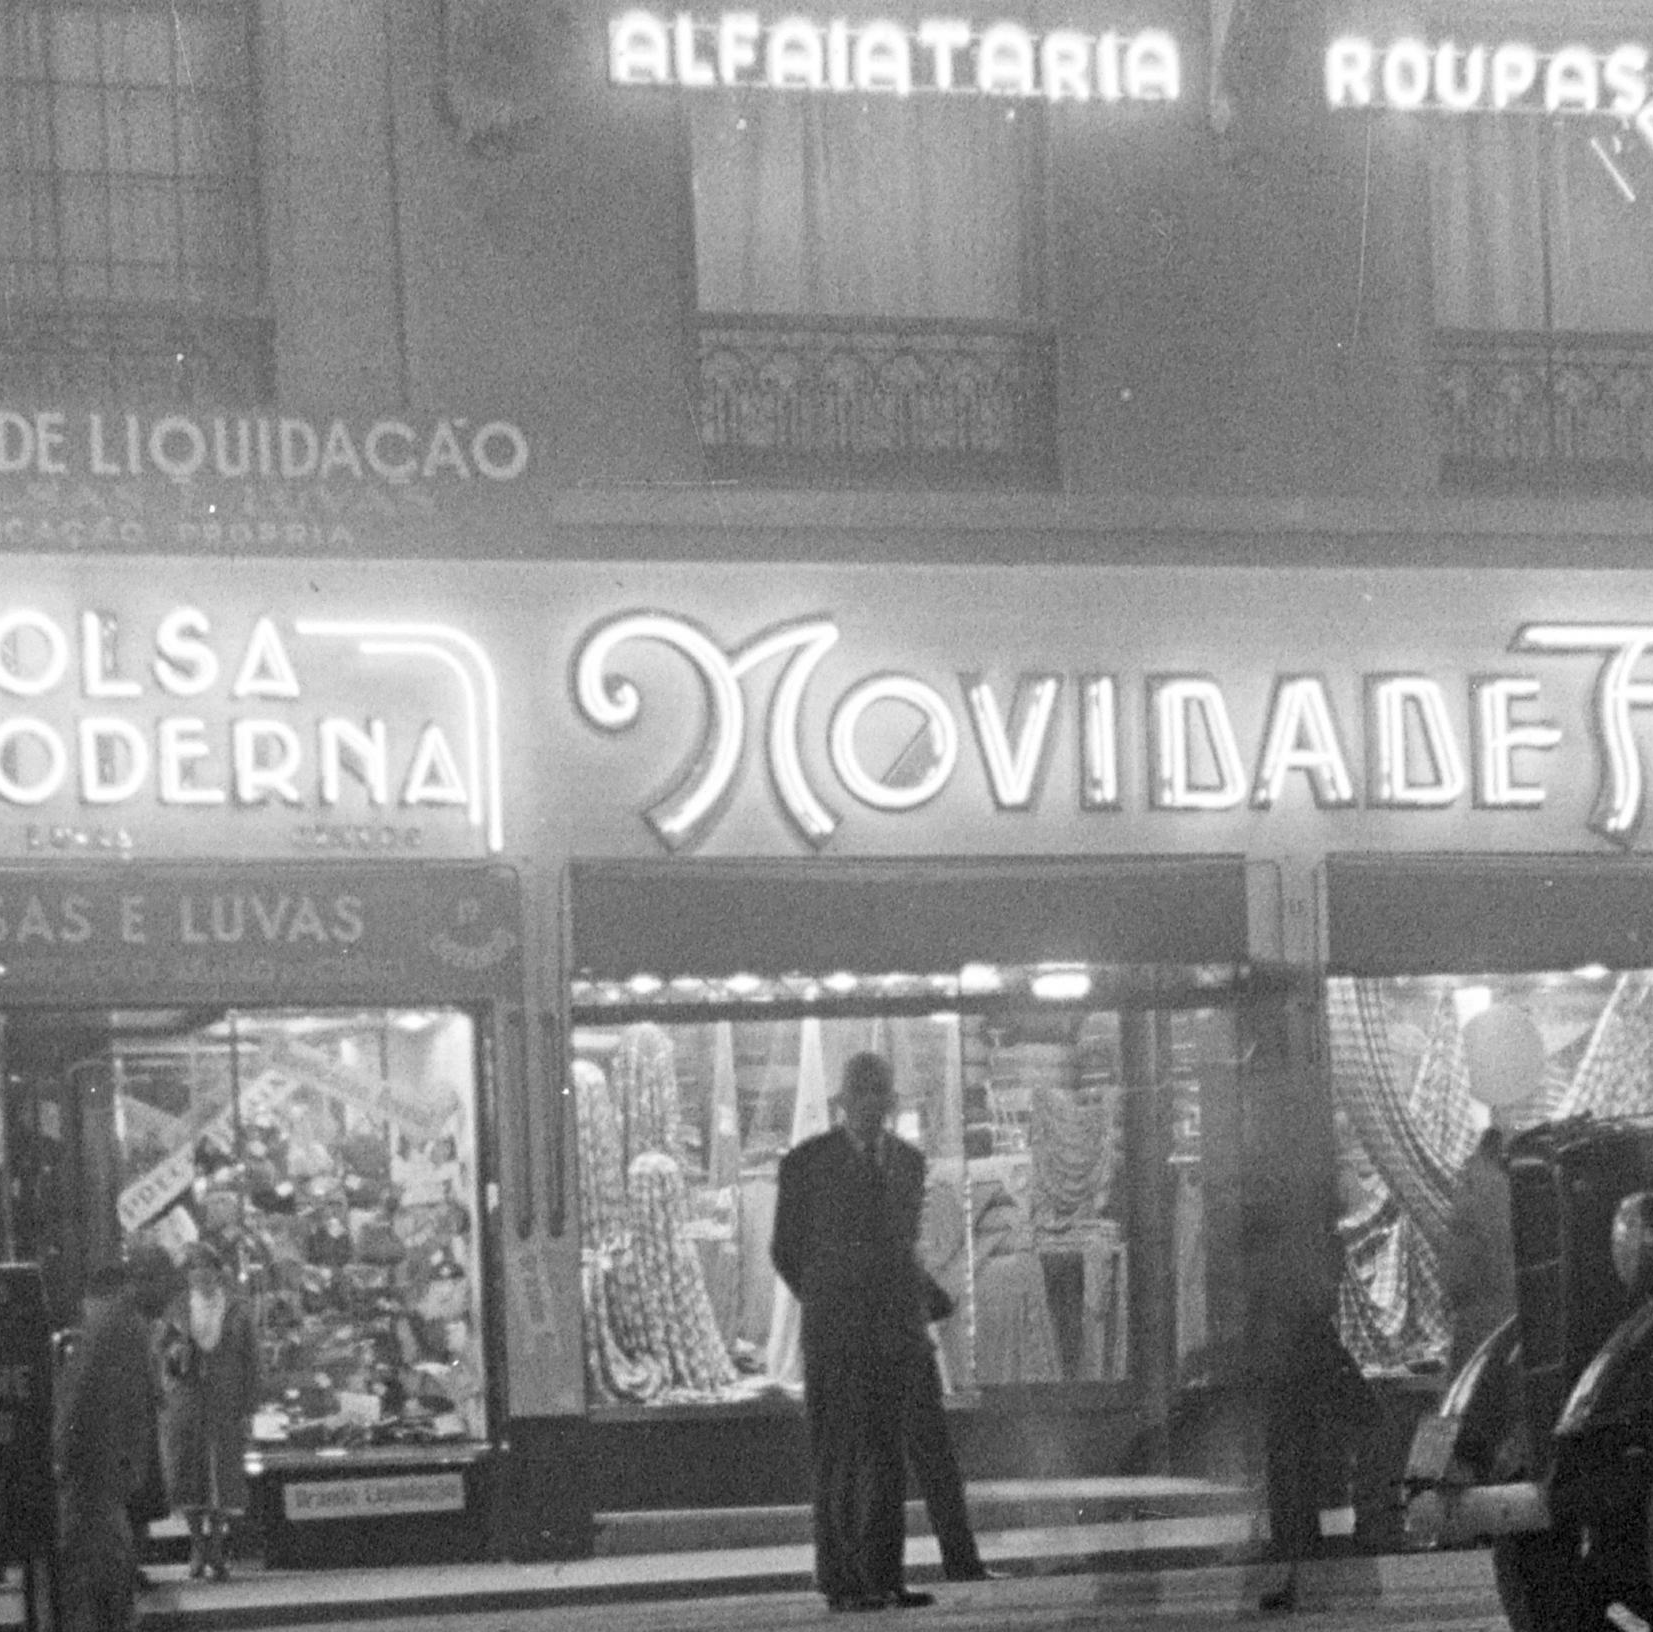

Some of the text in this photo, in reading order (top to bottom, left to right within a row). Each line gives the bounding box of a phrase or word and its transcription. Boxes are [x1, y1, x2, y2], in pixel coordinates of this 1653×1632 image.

[610, 13, 1180, 100] ALFAIATARIA
[1325, 37, 1649, 113] ROUPAS
[88, 413, 529, 486] LIQUIDAÇÃO
[568, 608, 1563, 852] NOVIDADE
[119, 895, 148, 944] E
[179, 894, 366, 945] LUVAS
